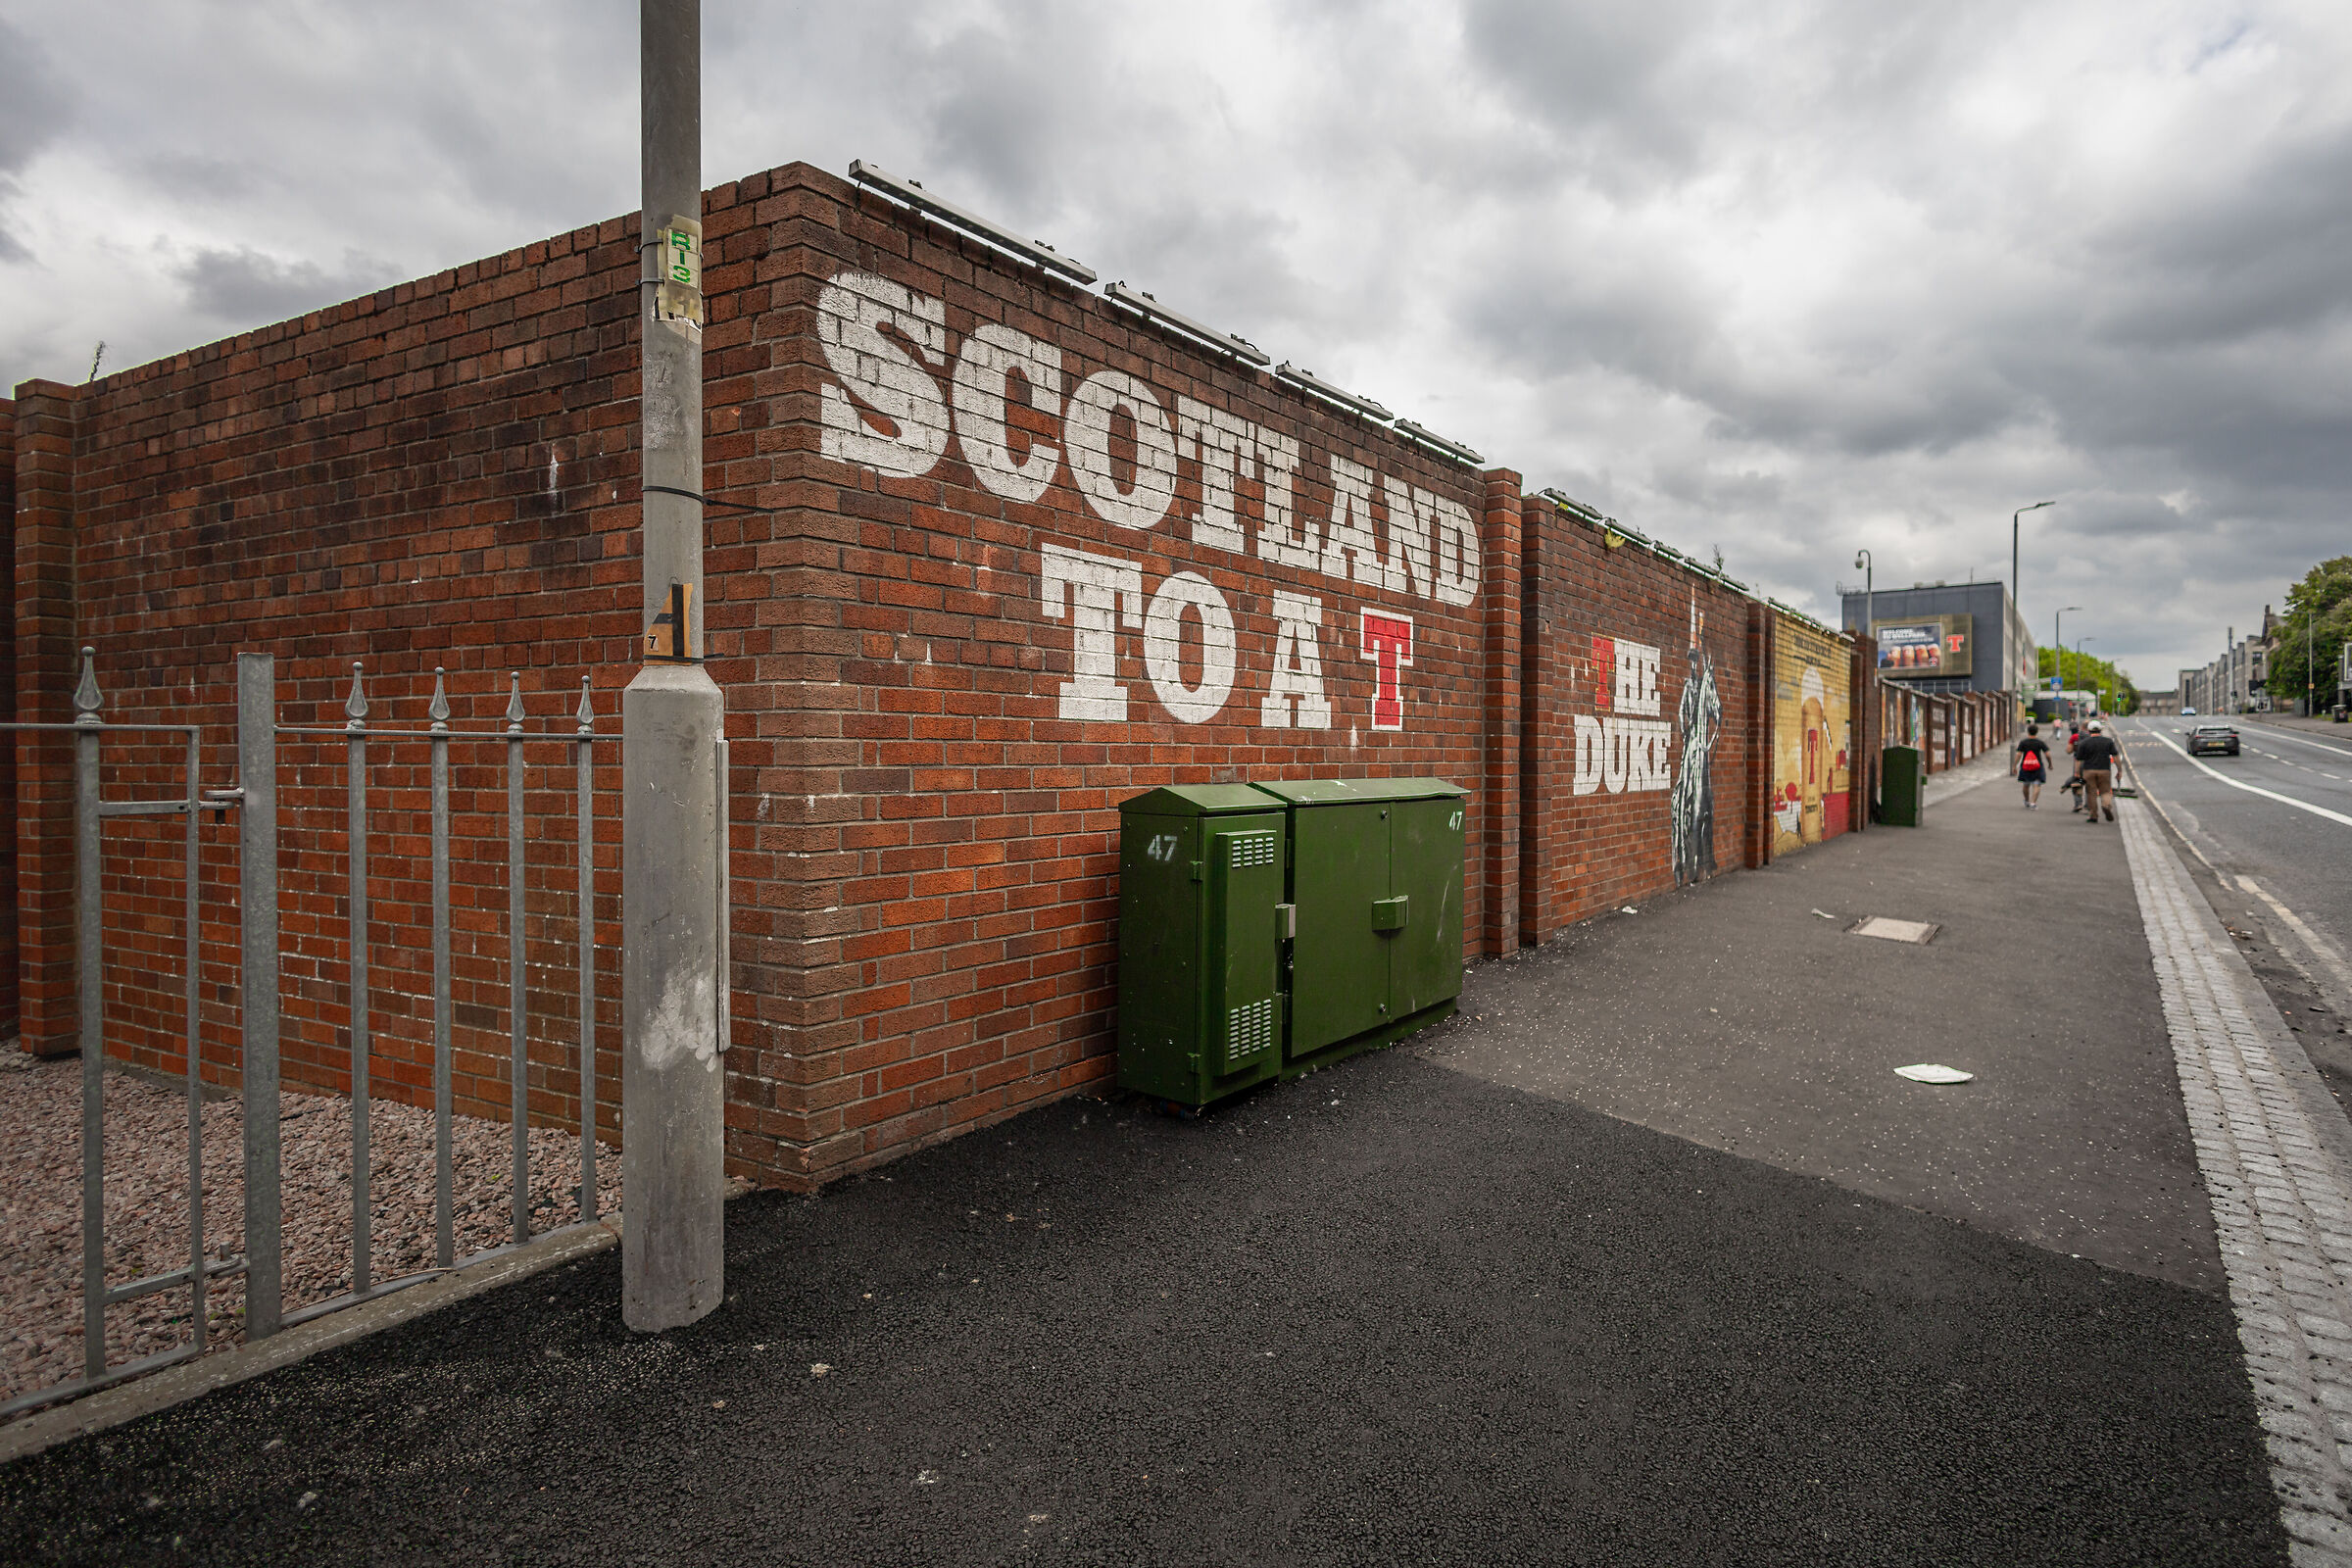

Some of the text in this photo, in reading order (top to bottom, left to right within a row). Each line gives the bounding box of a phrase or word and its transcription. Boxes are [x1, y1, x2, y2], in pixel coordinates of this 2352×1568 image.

[815, 271, 1481, 608] SCOTLAND
[648, 635, 657, 649] 7
[1042, 543, 1414, 731] TO A T
[1946, 634, 1964, 653] T
[1592, 632, 1661, 716] THE
[1573, 714, 1671, 796] DUKE
[1147, 834, 1177, 862] 47
[1448, 810, 1463, 831] 47
